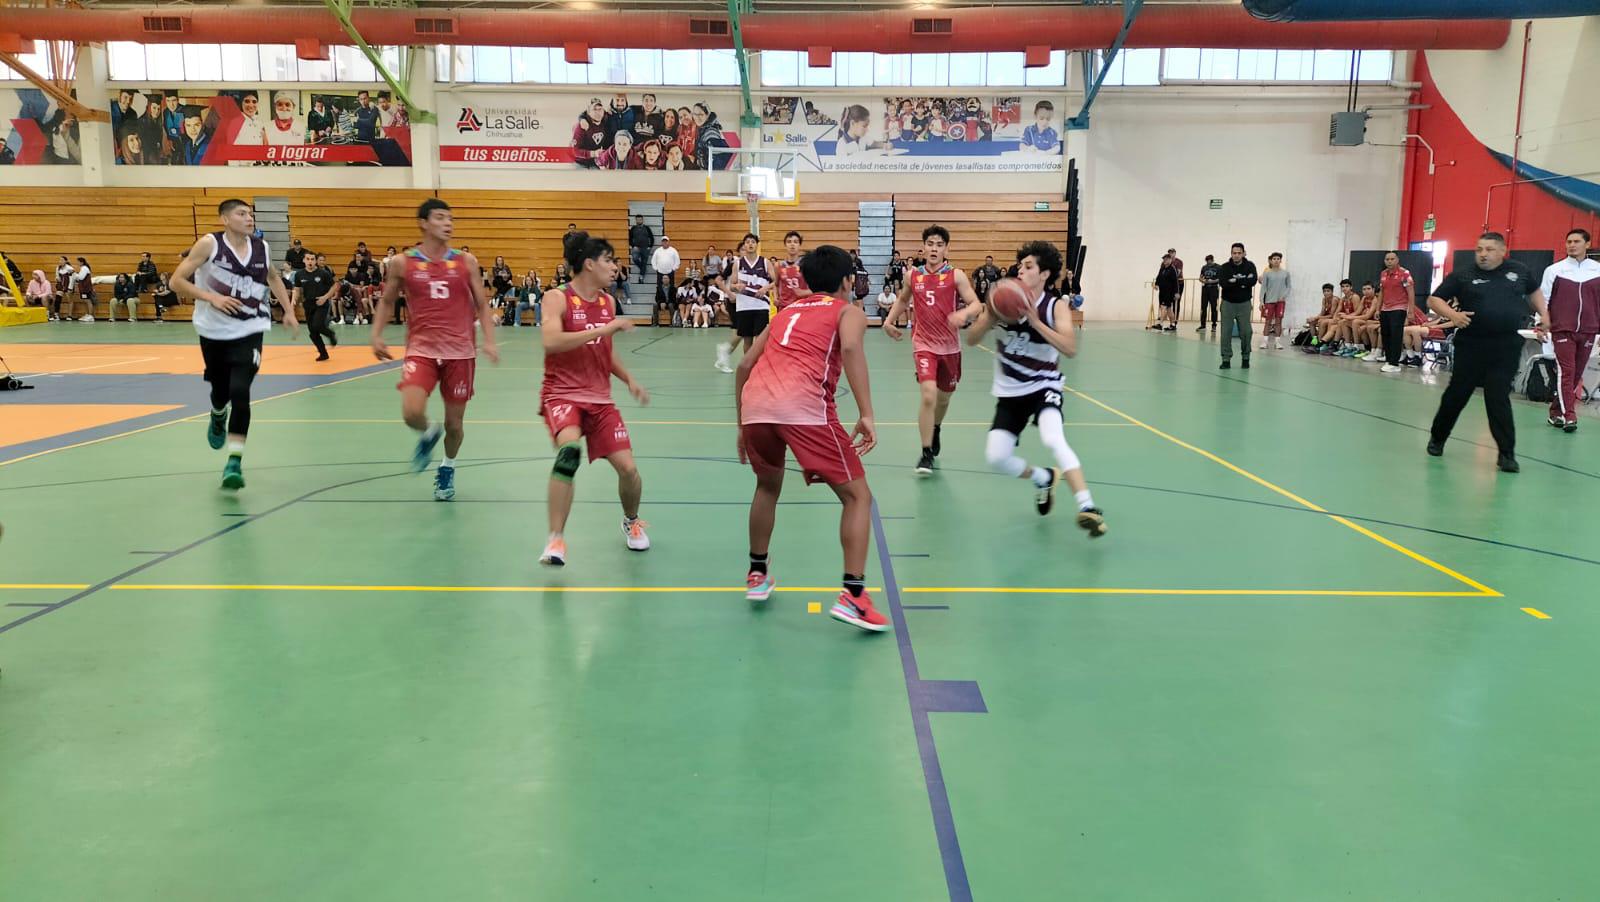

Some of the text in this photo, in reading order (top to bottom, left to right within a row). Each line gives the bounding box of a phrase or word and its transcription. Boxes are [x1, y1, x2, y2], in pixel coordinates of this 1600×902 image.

[485, 108, 537, 116] Universidad
[485, 115, 540, 130] La Salle
[763, 133, 808, 143] La Salle
[266, 145, 328, 160] a lograr
[463, 147, 560, 162] tus sueños...
[823, 162, 1062, 172] La sociedad necesita de jóvenes lasallistas comprometidos
[925, 290, 935, 306] 5
[779, 312, 801, 346] 1
[919, 358, 929, 368] 5
[551, 403, 573, 420] 27
